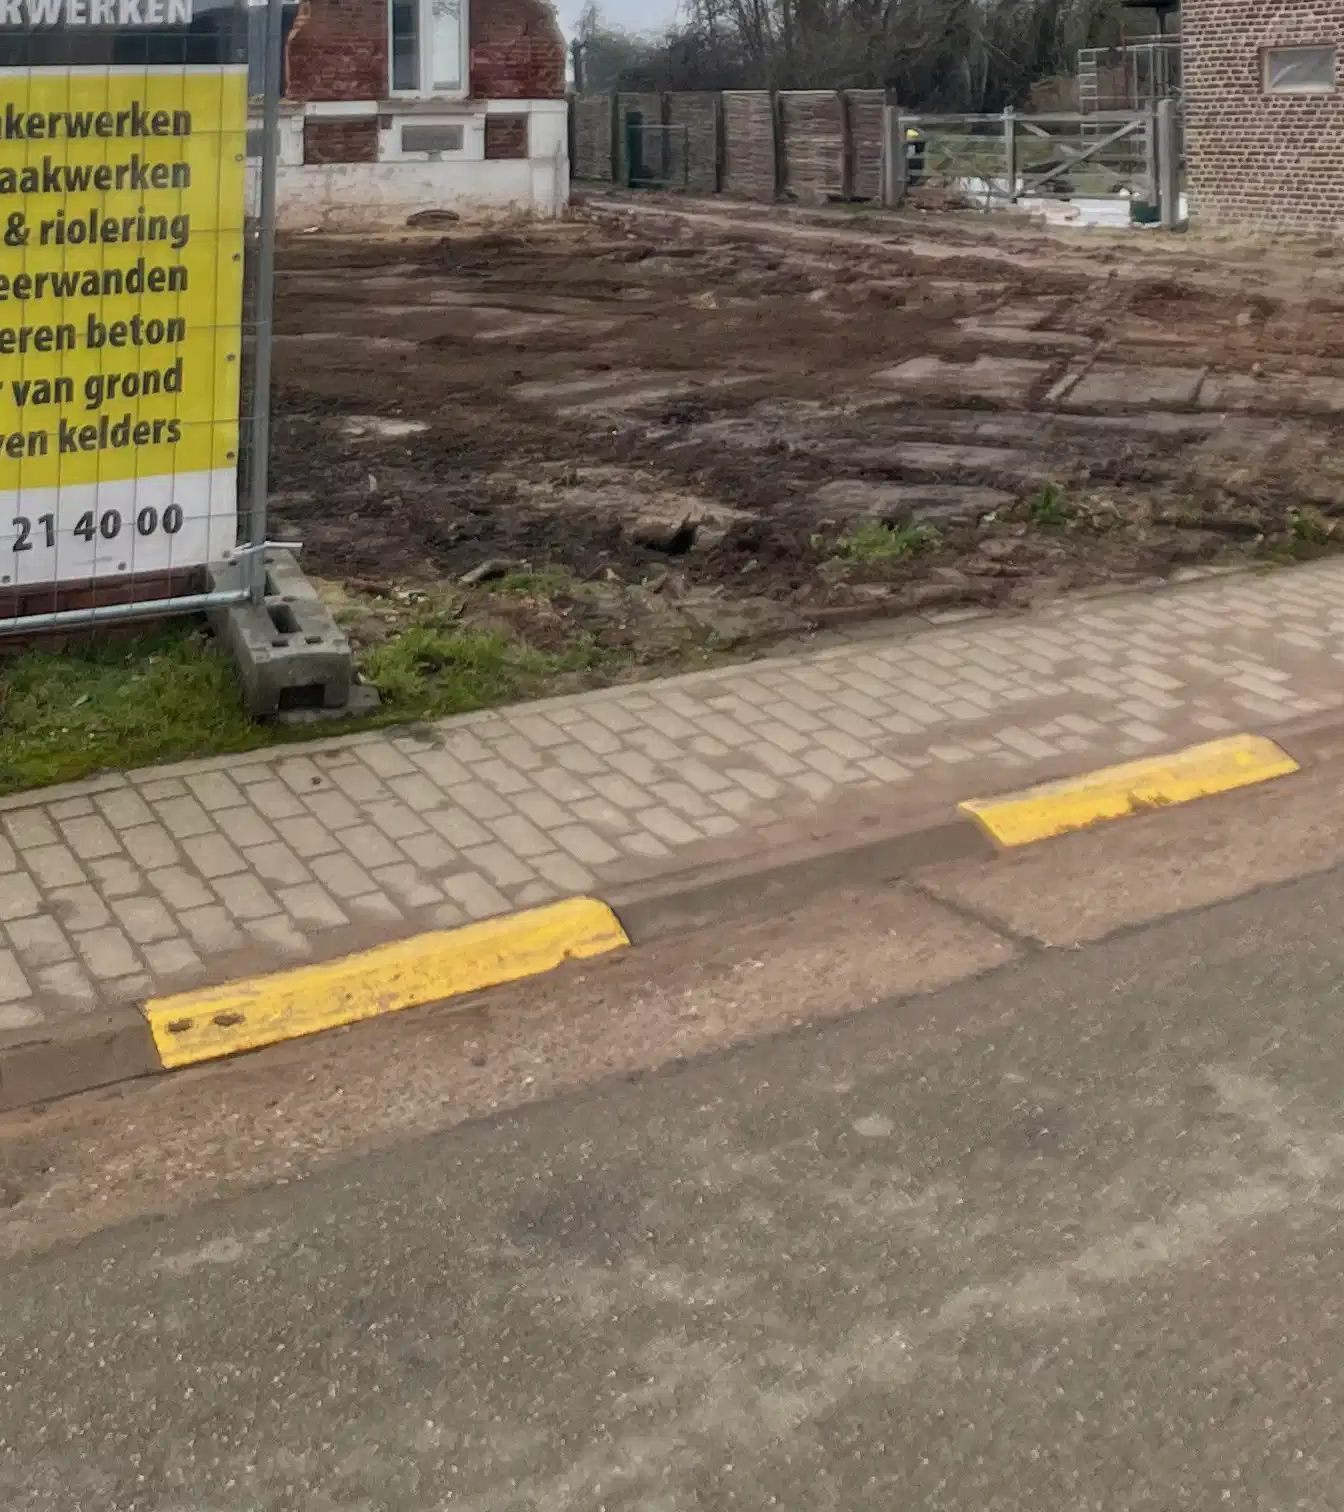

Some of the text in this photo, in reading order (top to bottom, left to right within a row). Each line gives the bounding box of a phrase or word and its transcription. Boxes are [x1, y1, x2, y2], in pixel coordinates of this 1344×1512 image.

[4, 211, 30, 246] &
[40, 207, 190, 249] riolering
[87, 312, 186, 349] beton
[13, 376, 74, 405] van
[84, 357, 184, 410] grond
[59, 414, 182, 454] kelders
[12, 513, 56, 552] 21
[74, 507, 123, 542] 40
[136, 502, 185, 537] 00
